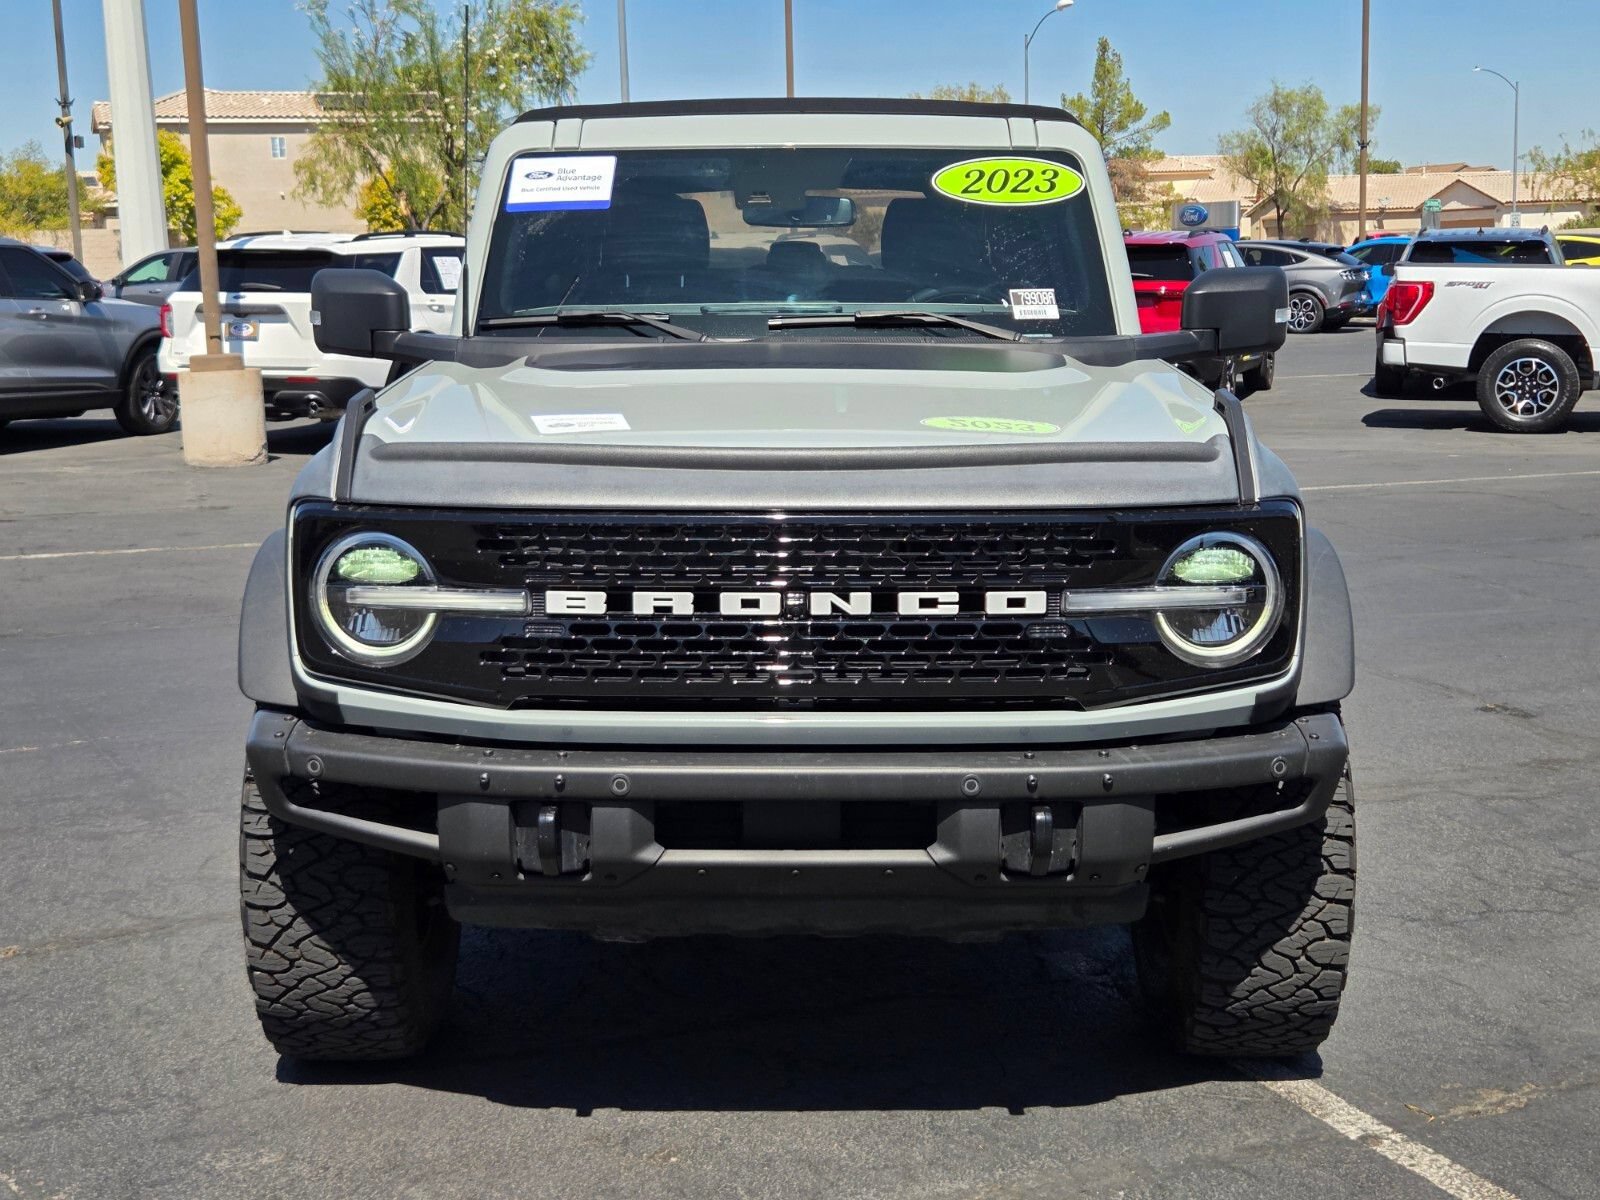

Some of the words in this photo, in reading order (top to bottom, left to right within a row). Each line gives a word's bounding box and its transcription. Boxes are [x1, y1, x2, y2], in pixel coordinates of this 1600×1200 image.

[961, 168, 1060, 194] 2023
[1018, 291, 1056, 305] 79908A
[545, 590, 1048, 616] BRONCO
